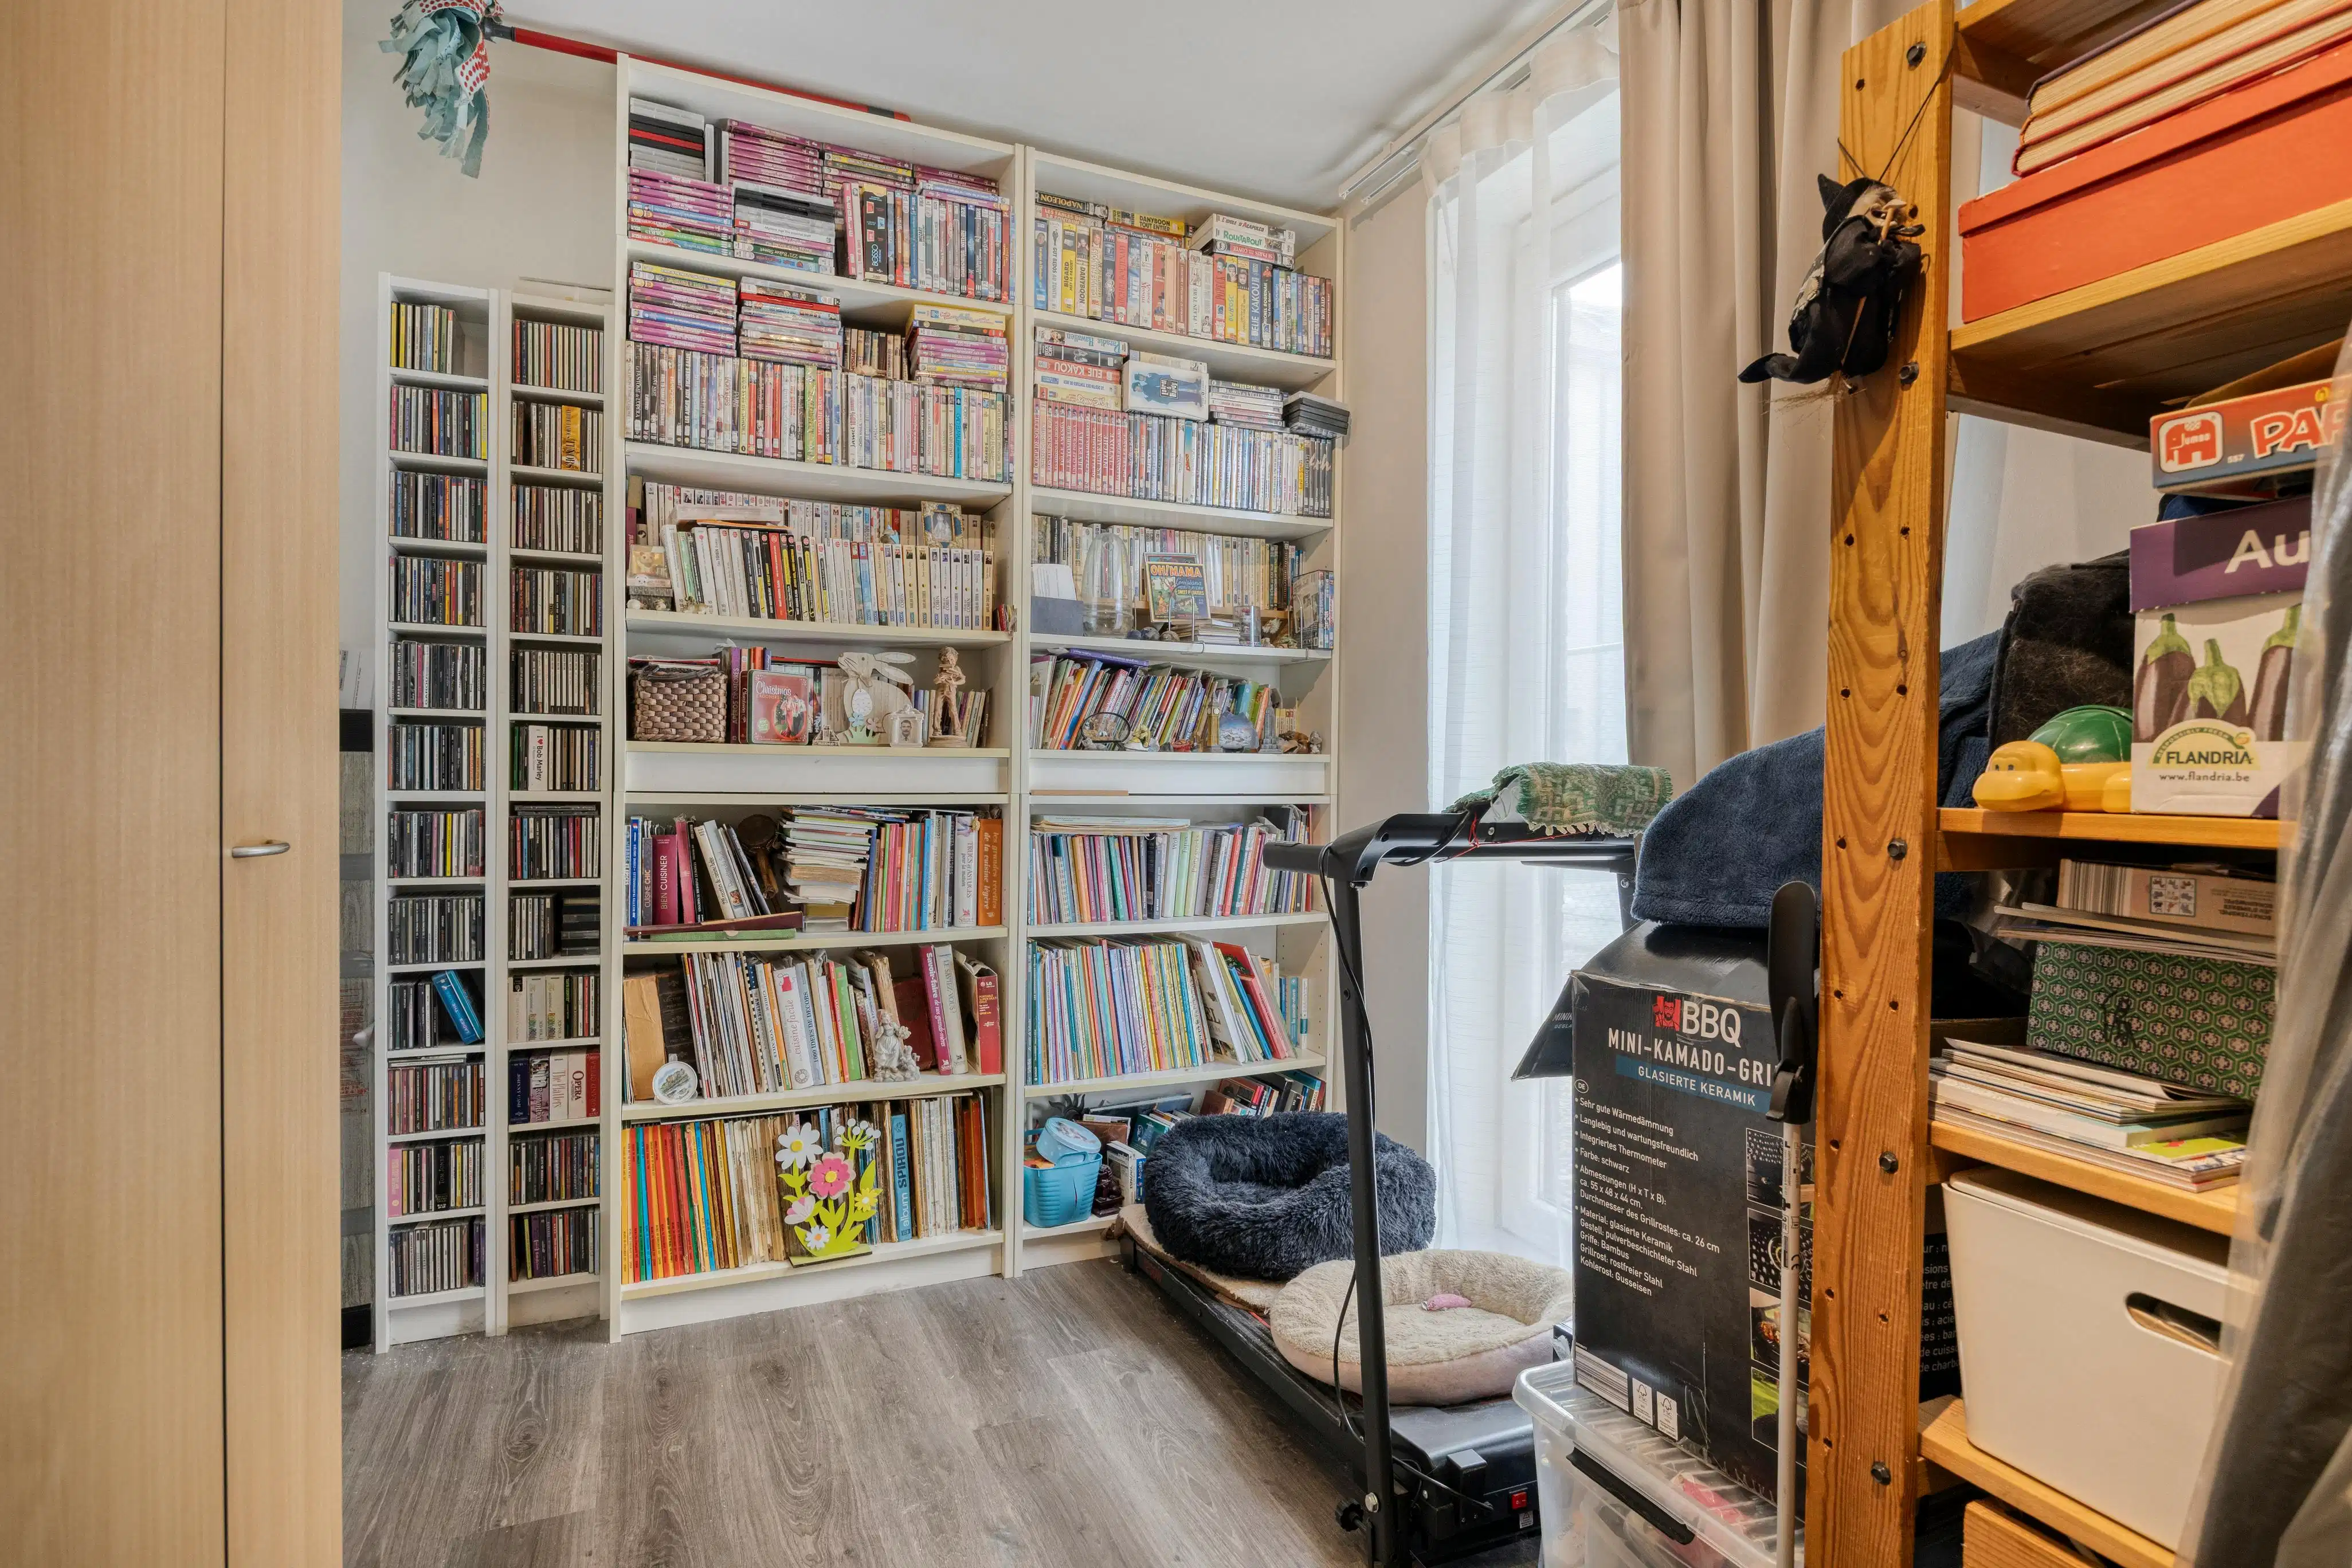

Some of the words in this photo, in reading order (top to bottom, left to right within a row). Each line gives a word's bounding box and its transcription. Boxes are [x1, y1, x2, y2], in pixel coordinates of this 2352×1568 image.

[1040, 194, 1083, 209] NAPOLEON
[1139, 215, 1170, 226] DANYBOON
[1153, 224, 1170, 232] ENTIER
[1223, 230, 1263, 246] ROUSTABOUT
[760, 247, 773, 255] Street
[774, 249, 787, 257] Baker
[1251, 281, 1259, 313] KAKOU
[1251, 316, 1259, 331] ELIE
[1054, 362, 1084, 375] KAKOU
[1088, 367, 1102, 378] ELIE
[2170, 431, 2212, 450] Jumbo
[1150, 565, 1170, 576] OH!
[1170, 566, 1202, 577] MAMA
[1175, 577, 1202, 586] Louisiana
[756, 680, 791, 696] Christmas
[535, 759, 543, 782] Marley
[2166, 751, 2254, 765] FLANDRIA
[2159, 772, 2250, 782] www.flandria.be
[984, 832, 990, 842] de
[982, 885, 990, 910] légère
[943, 960, 950, 968] LE
[786, 999, 799, 1024] facile
[803, 991, 812, 1019] DECORS
[926, 952, 938, 998] Savoir-faire
[935, 1016, 946, 1047] grands-mères
[807, 1020, 814, 1028] DE
[1682, 1001, 1742, 1048] BBQ
[790, 1025, 802, 1055] cuisine
[808, 1029, 816, 1048] IDEES
[811, 1049, 820, 1063] 1000
[552, 1083, 566, 1108] Platters
[573, 1071, 585, 1100] OPERA
[1638, 1065, 1696, 1091] GLASIERTE
[1700, 1082, 1756, 1107] KERAMIK
[1580, 1097, 1594, 1110] Sehr
[1596, 1104, 1610, 1115] gute
[1612, 1107, 1673, 1136] Wärmedämmung
[1580, 1114, 1611, 1134] Langlebig
[1613, 1126, 1625, 1137] und
[1627, 1131, 1698, 1162] wartungsfreundlich
[1580, 1131, 1617, 1151] Integriertes
[1618, 1144, 1667, 1169] Thermometer
[895, 1137, 908, 1189] SPIROU
[1580, 1147, 1600, 1163] Farbe:
[1601, 1156, 1630, 1173] schwarz
[1580, 1165, 1627, 1191] Abmessungen
[1628, 1183, 1636, 1194] (H
[1644, 1188, 1649, 1198] T
[1656, 1193, 1667, 1205] B):
[1580, 1178, 1589, 1187] ca.
[1590, 1181, 1598, 1191] 55
[1605, 1185, 1613, 1197] 48
[1614, 1191, 1618, 1199] x
[1620, 1191, 1628, 1204] 44
[1630, 1198, 1643, 1210] cm.
[900, 1193, 910, 1226] album
[1580, 1189, 1624, 1214] Durchmesser
[1626, 1208, 1638, 1221] des
[1640, 1214, 1680, 1237] Grillrostes:
[1682, 1232, 1693, 1243] ca.
[1695, 1236, 1705, 1248] 26
[1707, 1242, 1720, 1253] cm
[1580, 1205, 1608, 1225] Material:
[1610, 1220, 1640, 1239] glasierte
[1641, 1232, 1673, 1253] Keramik
[1580, 1230, 1600, 1246] Griffe:
[1601, 1240, 1629, 1260] Bambus
[1580, 1218, 1604, 1236] Gestell:
[1606, 1230, 1675, 1267] pulverbeschichteter
[1677, 1261, 1698, 1277] Stahl
[1580, 1244, 1608, 1263] Grillrost:
[1610, 1257, 1643, 1278] rostfreier
[1644, 1272, 1663, 1288] Stahl
[1580, 1255, 1614, 1278] Kohlerost:
[1615, 1272, 1652, 1296] Gusseisen
